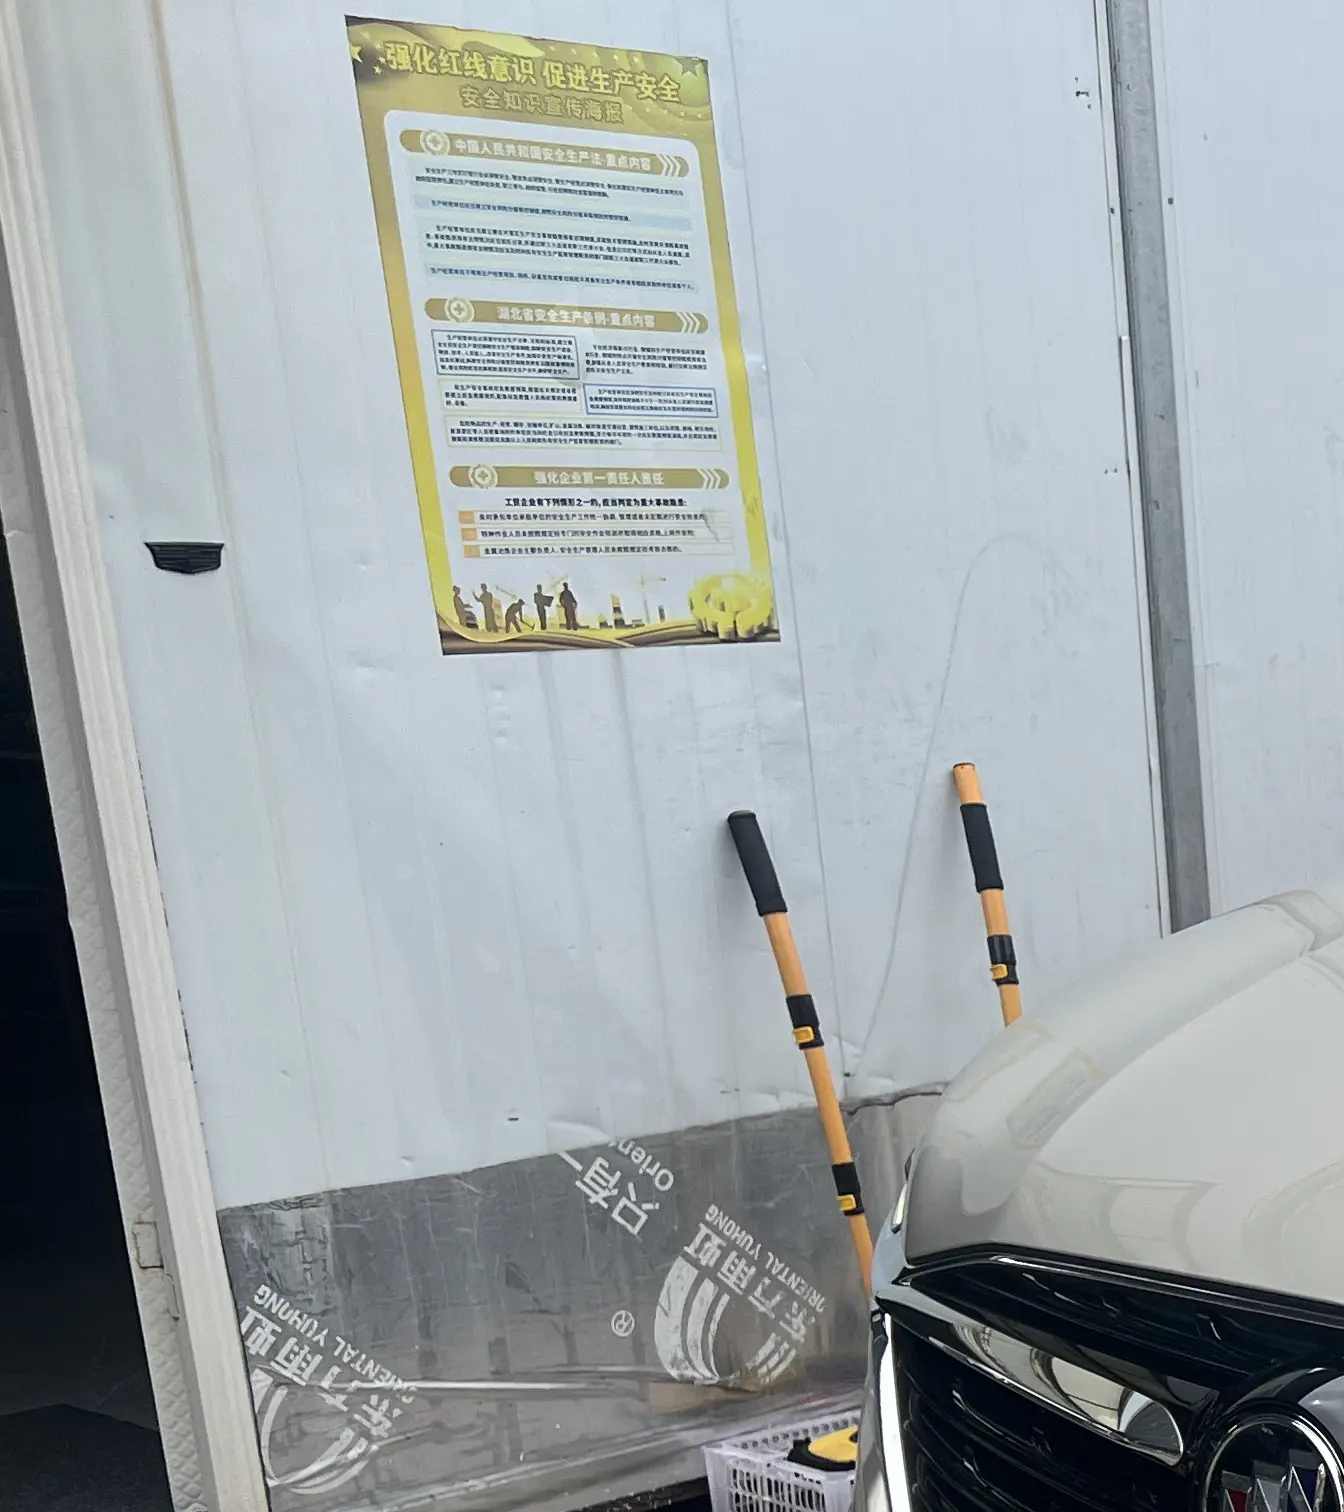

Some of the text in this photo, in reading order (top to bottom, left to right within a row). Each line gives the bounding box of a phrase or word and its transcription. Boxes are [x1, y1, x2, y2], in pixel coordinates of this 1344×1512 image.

[385, 41, 682, 103] 强化红线意识 促进生产安全
[460, 84, 624, 123] 安全知识宣传海报
[608, 1140, 674, 1191] Orien
[705, 1204, 761, 1260] YUHONG
[684, 1222, 815, 1343] 东方雨虹
[254, 1284, 329, 1346] YUHONG
[240, 1306, 402, 1438] 东方雨虹
